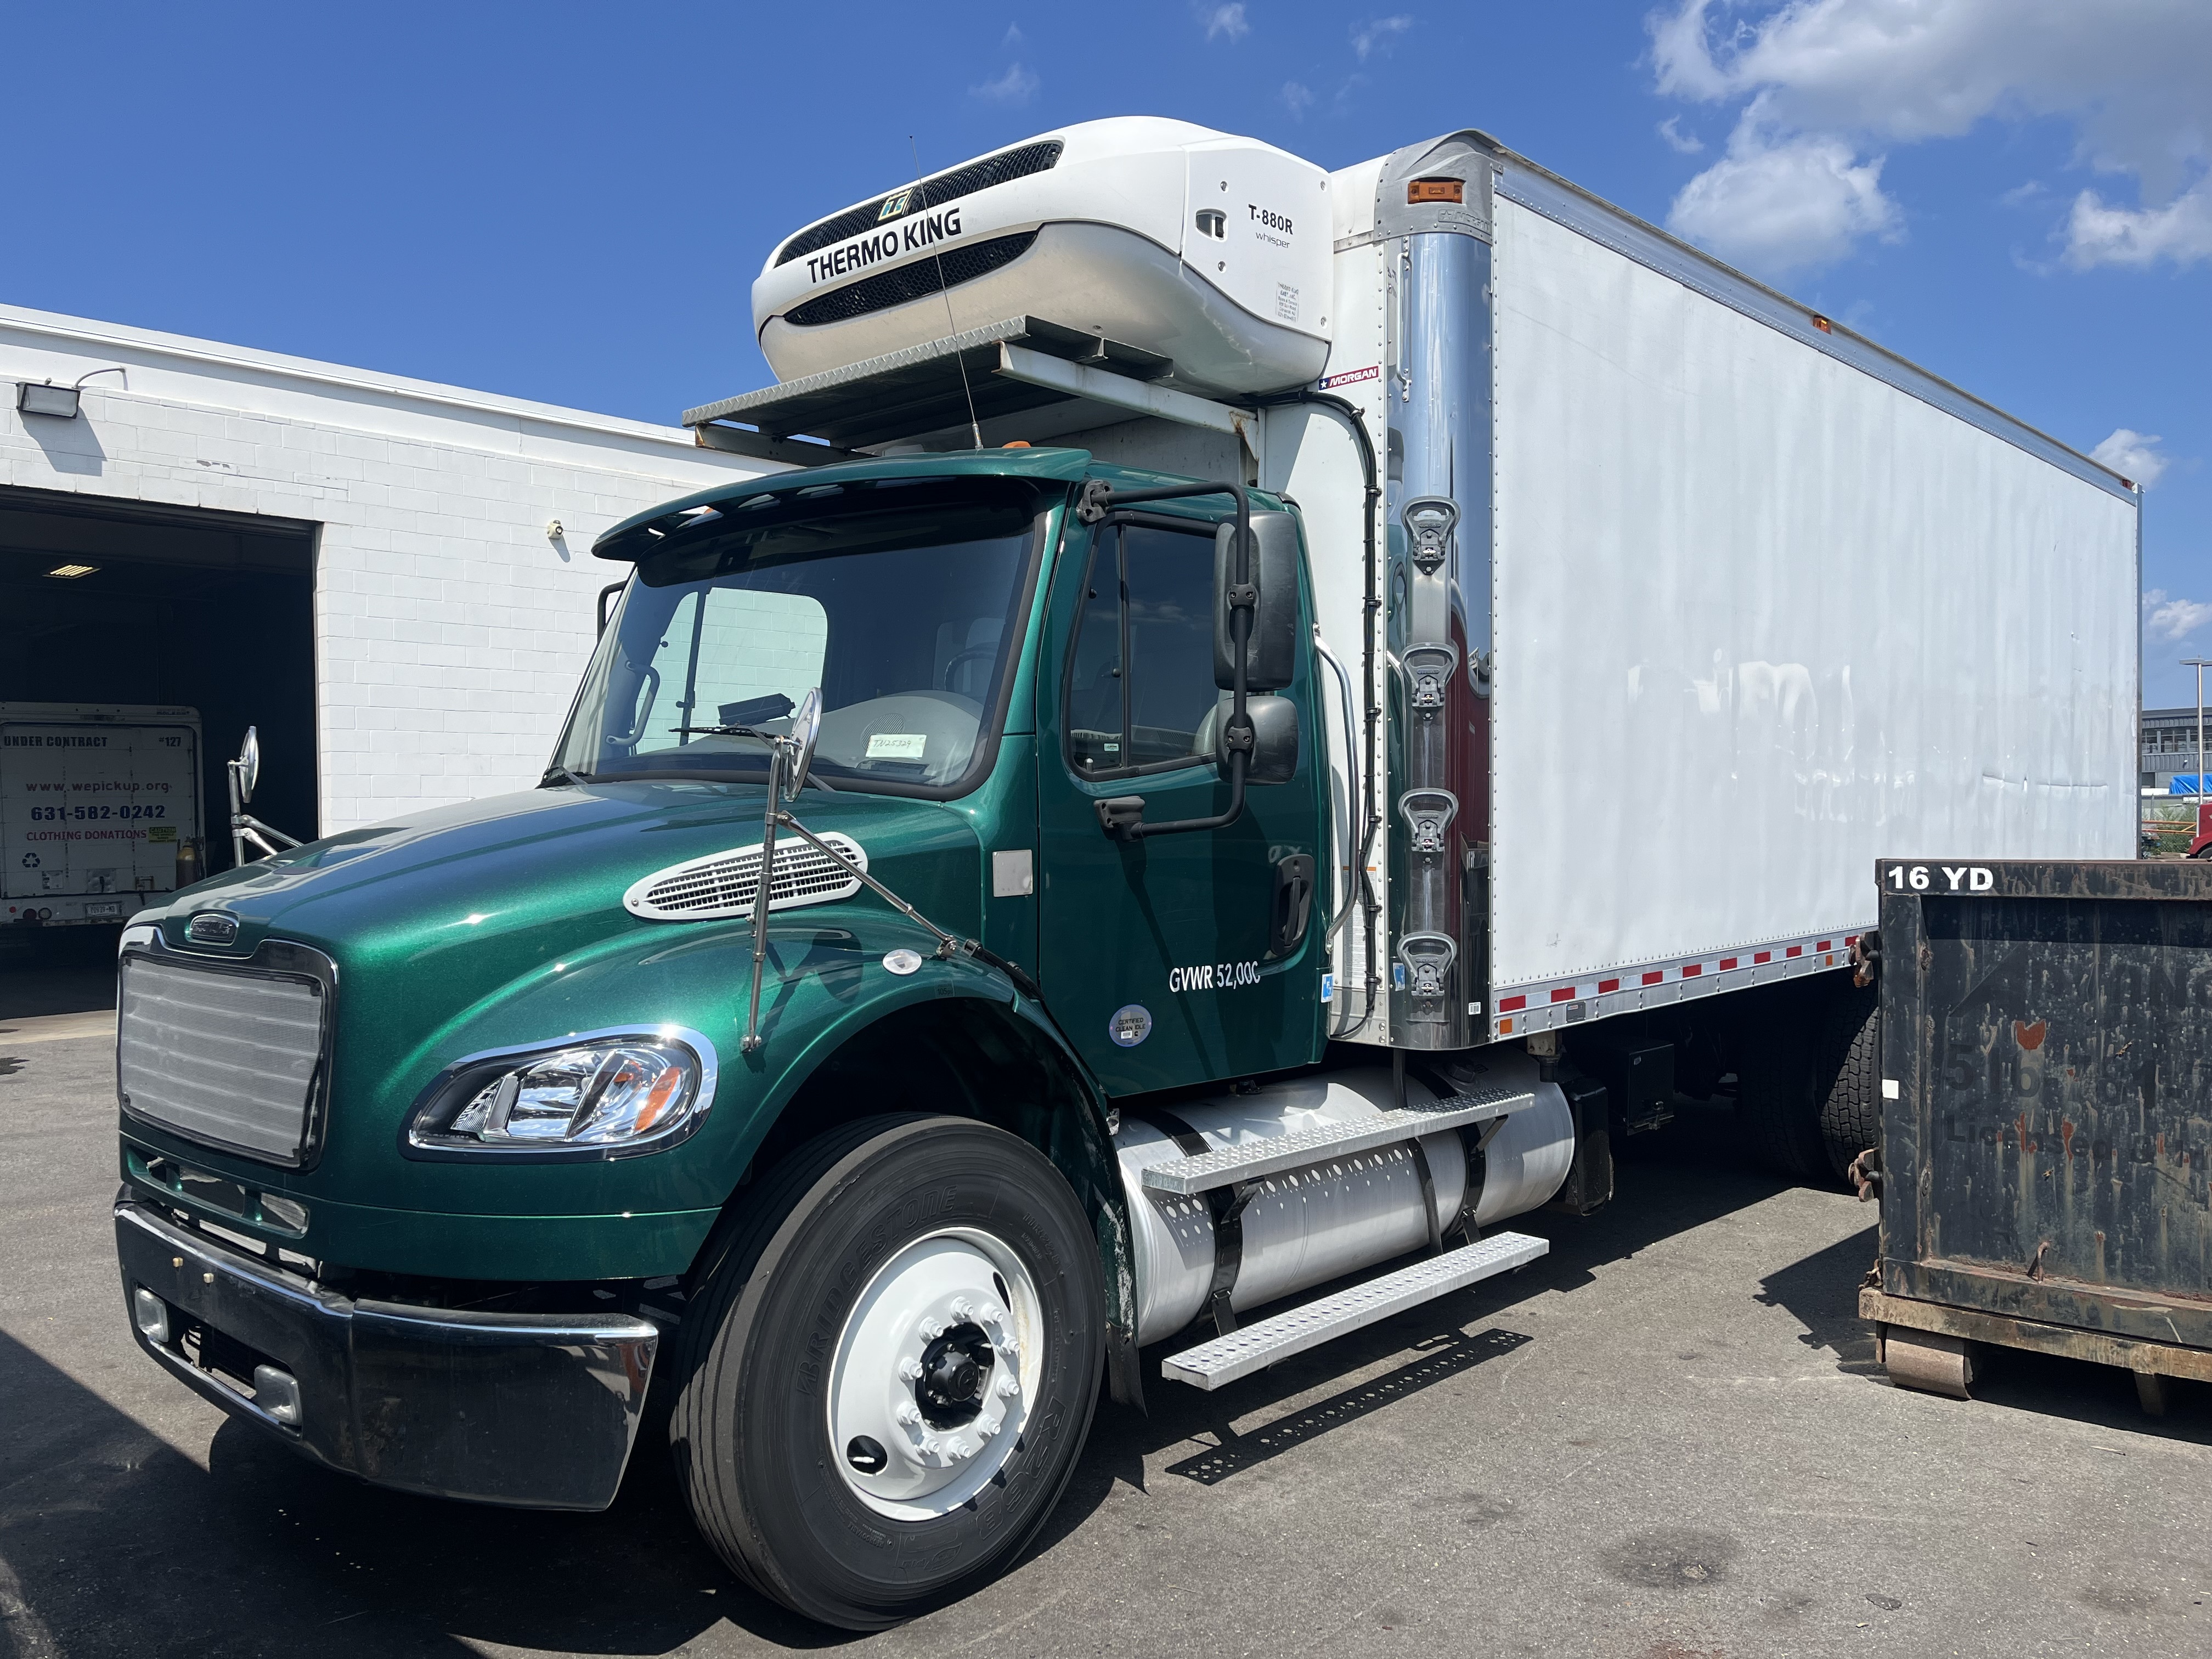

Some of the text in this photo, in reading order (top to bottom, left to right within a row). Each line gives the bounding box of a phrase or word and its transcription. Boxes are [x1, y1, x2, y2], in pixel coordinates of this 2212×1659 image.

[1248, 204, 1294, 235] T-880R
[807, 207, 962, 284] THERMO KING
[1255, 231, 1290, 249] whisper
[1329, 368, 1376, 387] MORGAN
[4, 736, 108, 747] UNDER CONTRACT
[159, 736, 182, 747] #127
[26, 781, 170, 793] www.wepickup.org
[31, 805, 166, 821] 631-582-0242
[26, 831, 82, 841] CLOTHING
[84, 830, 147, 839] DONATIONS
[1888, 866, 1994, 891] 16 YD
[1169, 964, 1214, 993] GVWR
[1118, 1017, 1144, 1025] CERTIFIED
[797, 1184, 958, 1397] BRIDGESTONE
[975, 1395, 1068, 1541] R268
